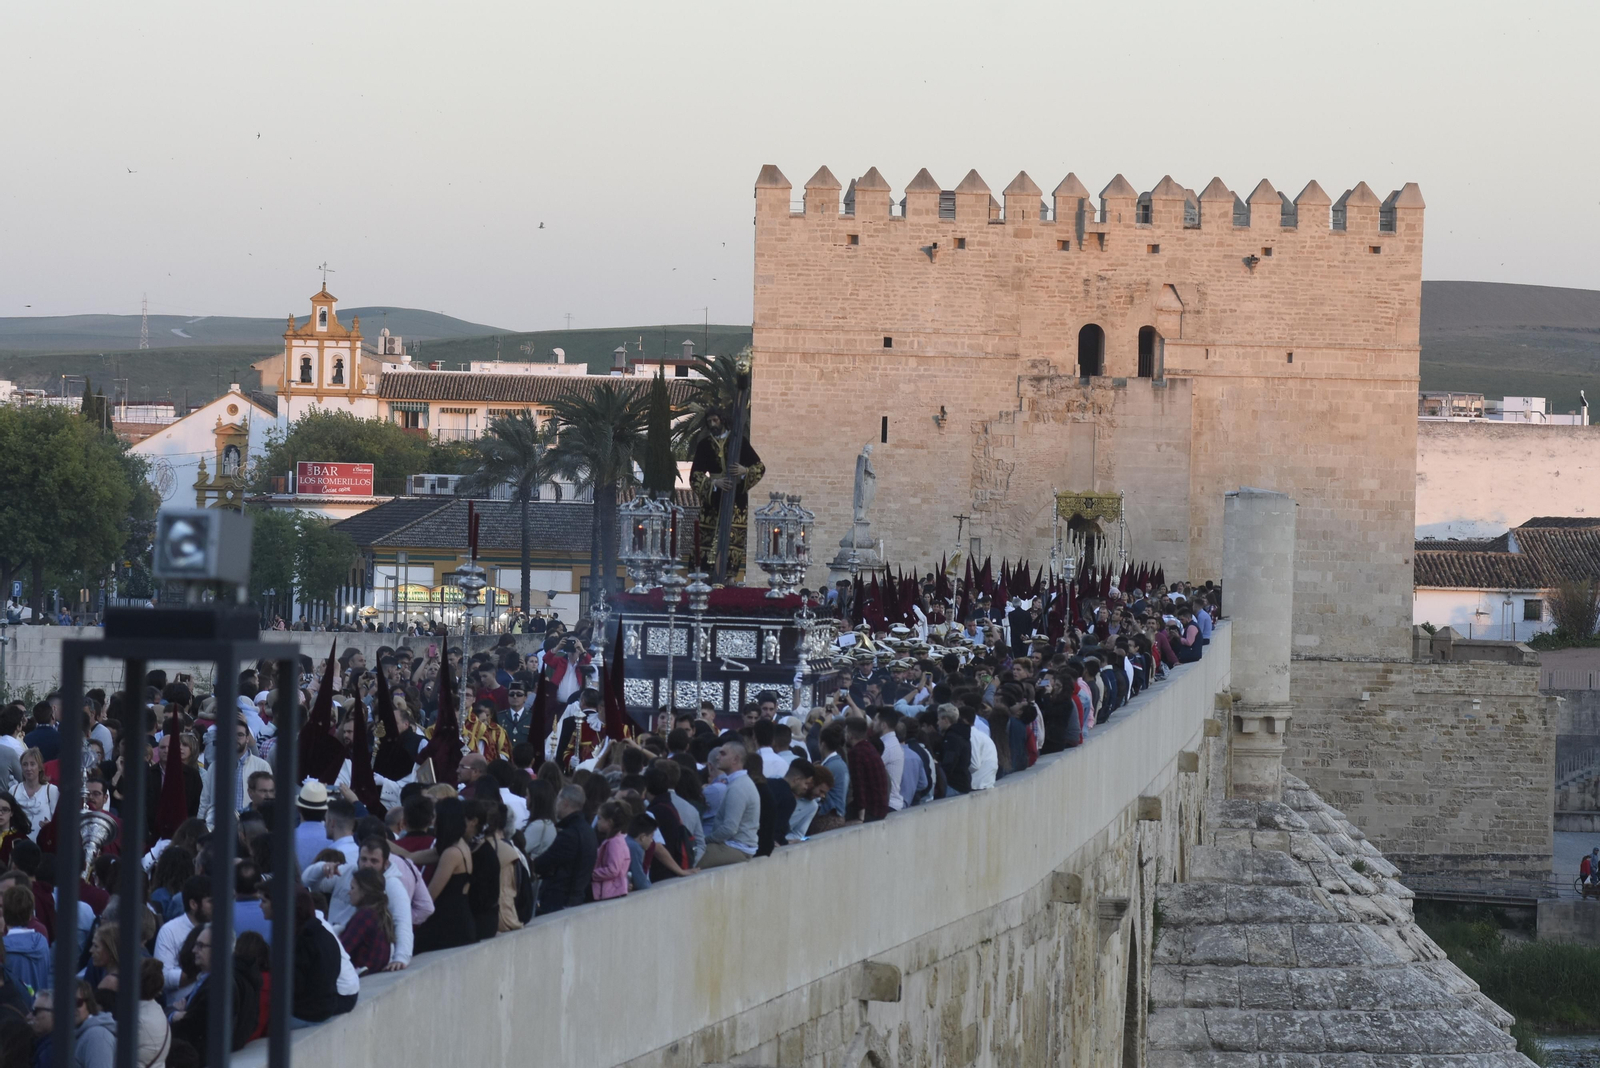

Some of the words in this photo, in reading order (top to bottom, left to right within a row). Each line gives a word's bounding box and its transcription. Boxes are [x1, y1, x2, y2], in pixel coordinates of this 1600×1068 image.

[313, 466, 338, 476] BAR
[300, 477, 316, 485] LOS
[317, 477, 371, 486] ROMERILLOS
[15, 583, 20, 595] P
